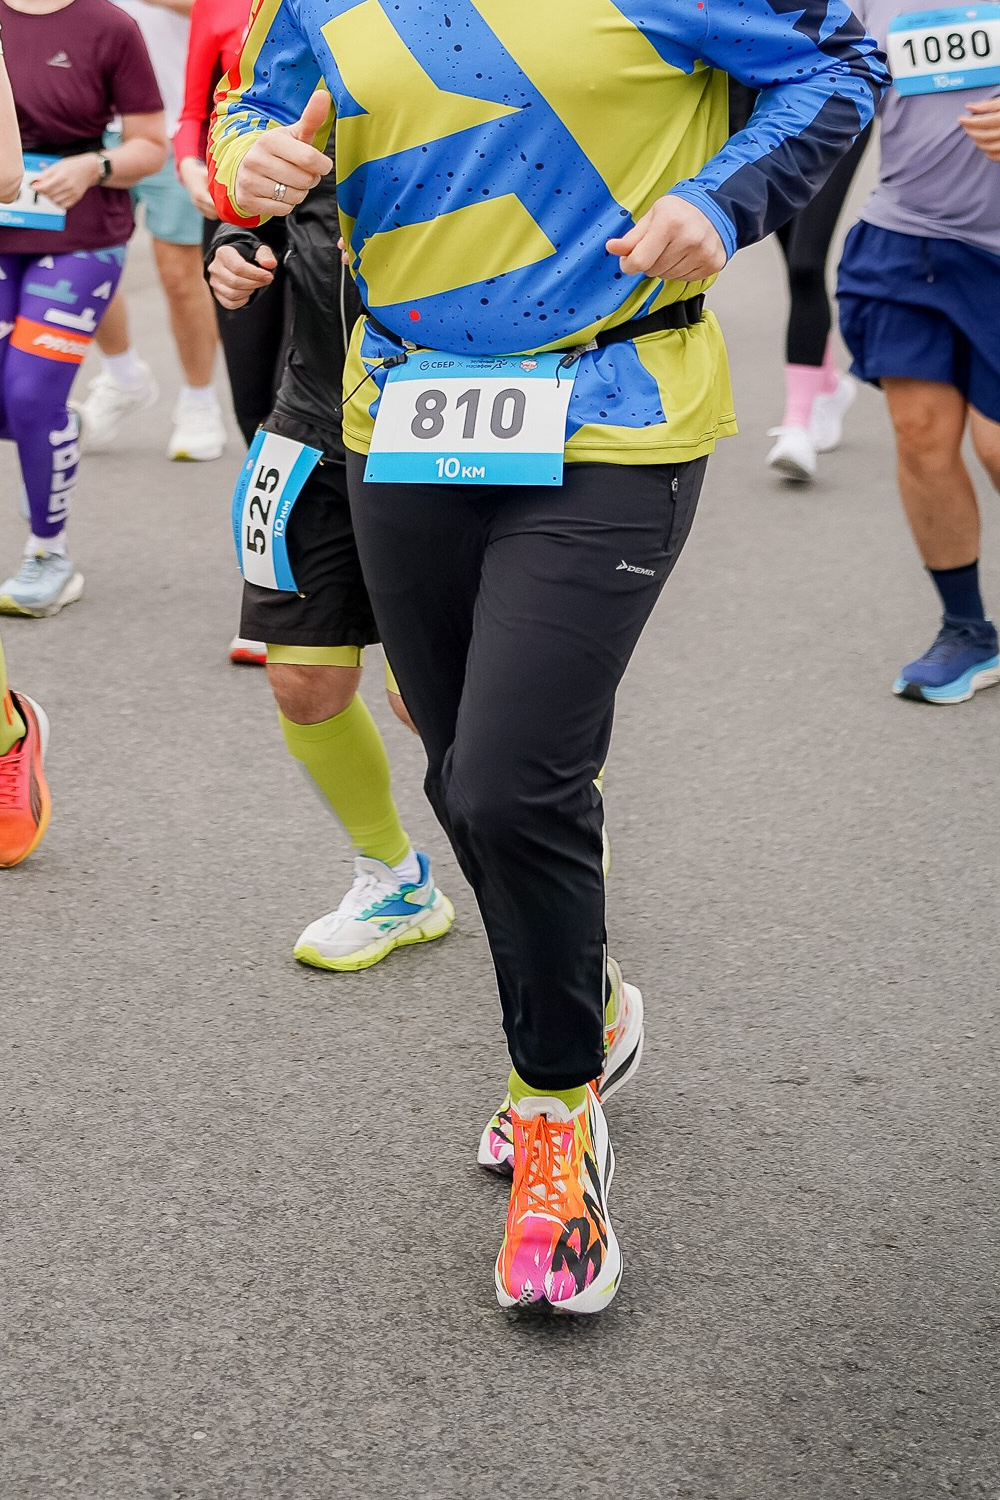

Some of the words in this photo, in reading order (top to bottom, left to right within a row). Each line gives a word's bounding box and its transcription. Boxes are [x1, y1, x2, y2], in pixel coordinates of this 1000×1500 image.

[902, 30, 991, 66] 1080
[431, 361, 455, 369] СБЕР
[410, 388, 526, 439] 810
[246, 465, 280, 556] 525
[627, 565, 656, 577] DEMIX
